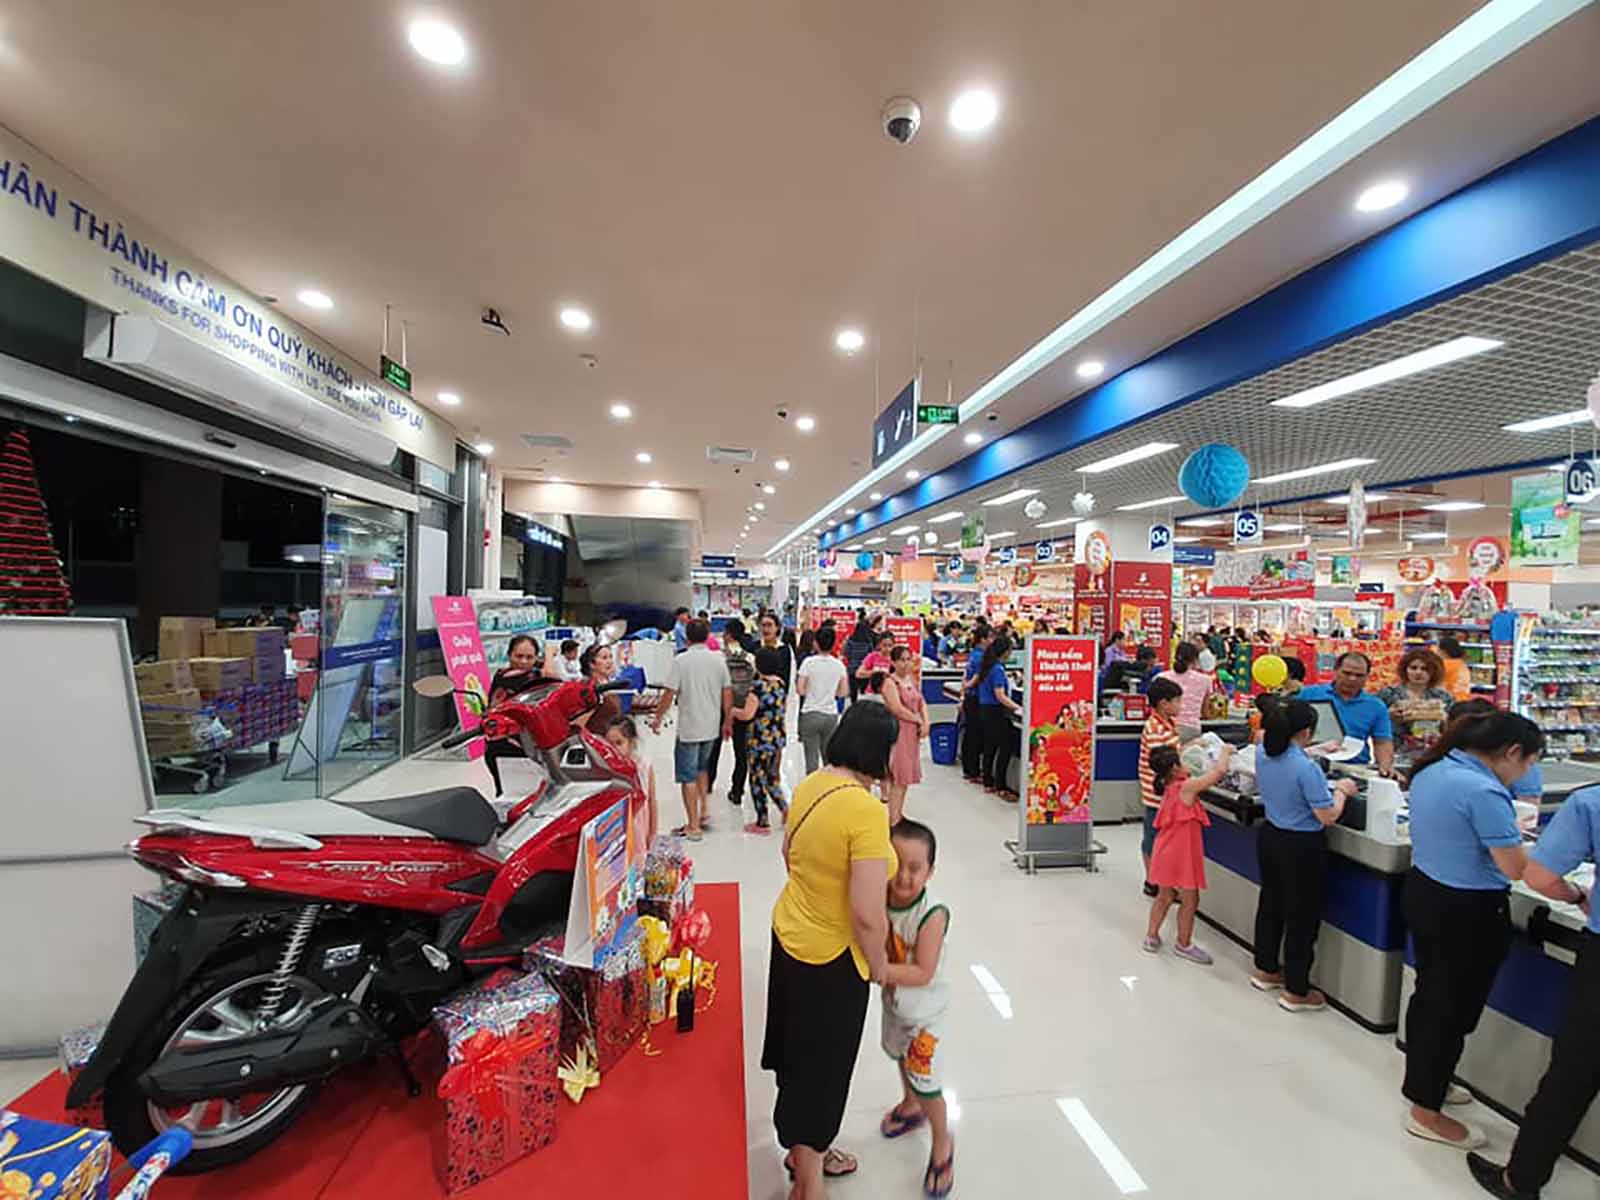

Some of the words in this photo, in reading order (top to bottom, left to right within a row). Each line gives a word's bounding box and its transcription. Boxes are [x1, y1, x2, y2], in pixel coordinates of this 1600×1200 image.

[68, 200, 168, 283] THÀNH
[306, 348, 353, 390] KHÁCH
[110, 266, 179, 315] THANKS
[181, 306, 211, 334] FOR
[213, 325, 278, 369] SHOPPING
[279, 359, 305, 381] WITH
[1569, 470, 1593, 492] 06
[1238, 519, 1256, 533] 05
[1151, 531, 1168, 543] 04
[1037, 649, 1060, 660] Mua
